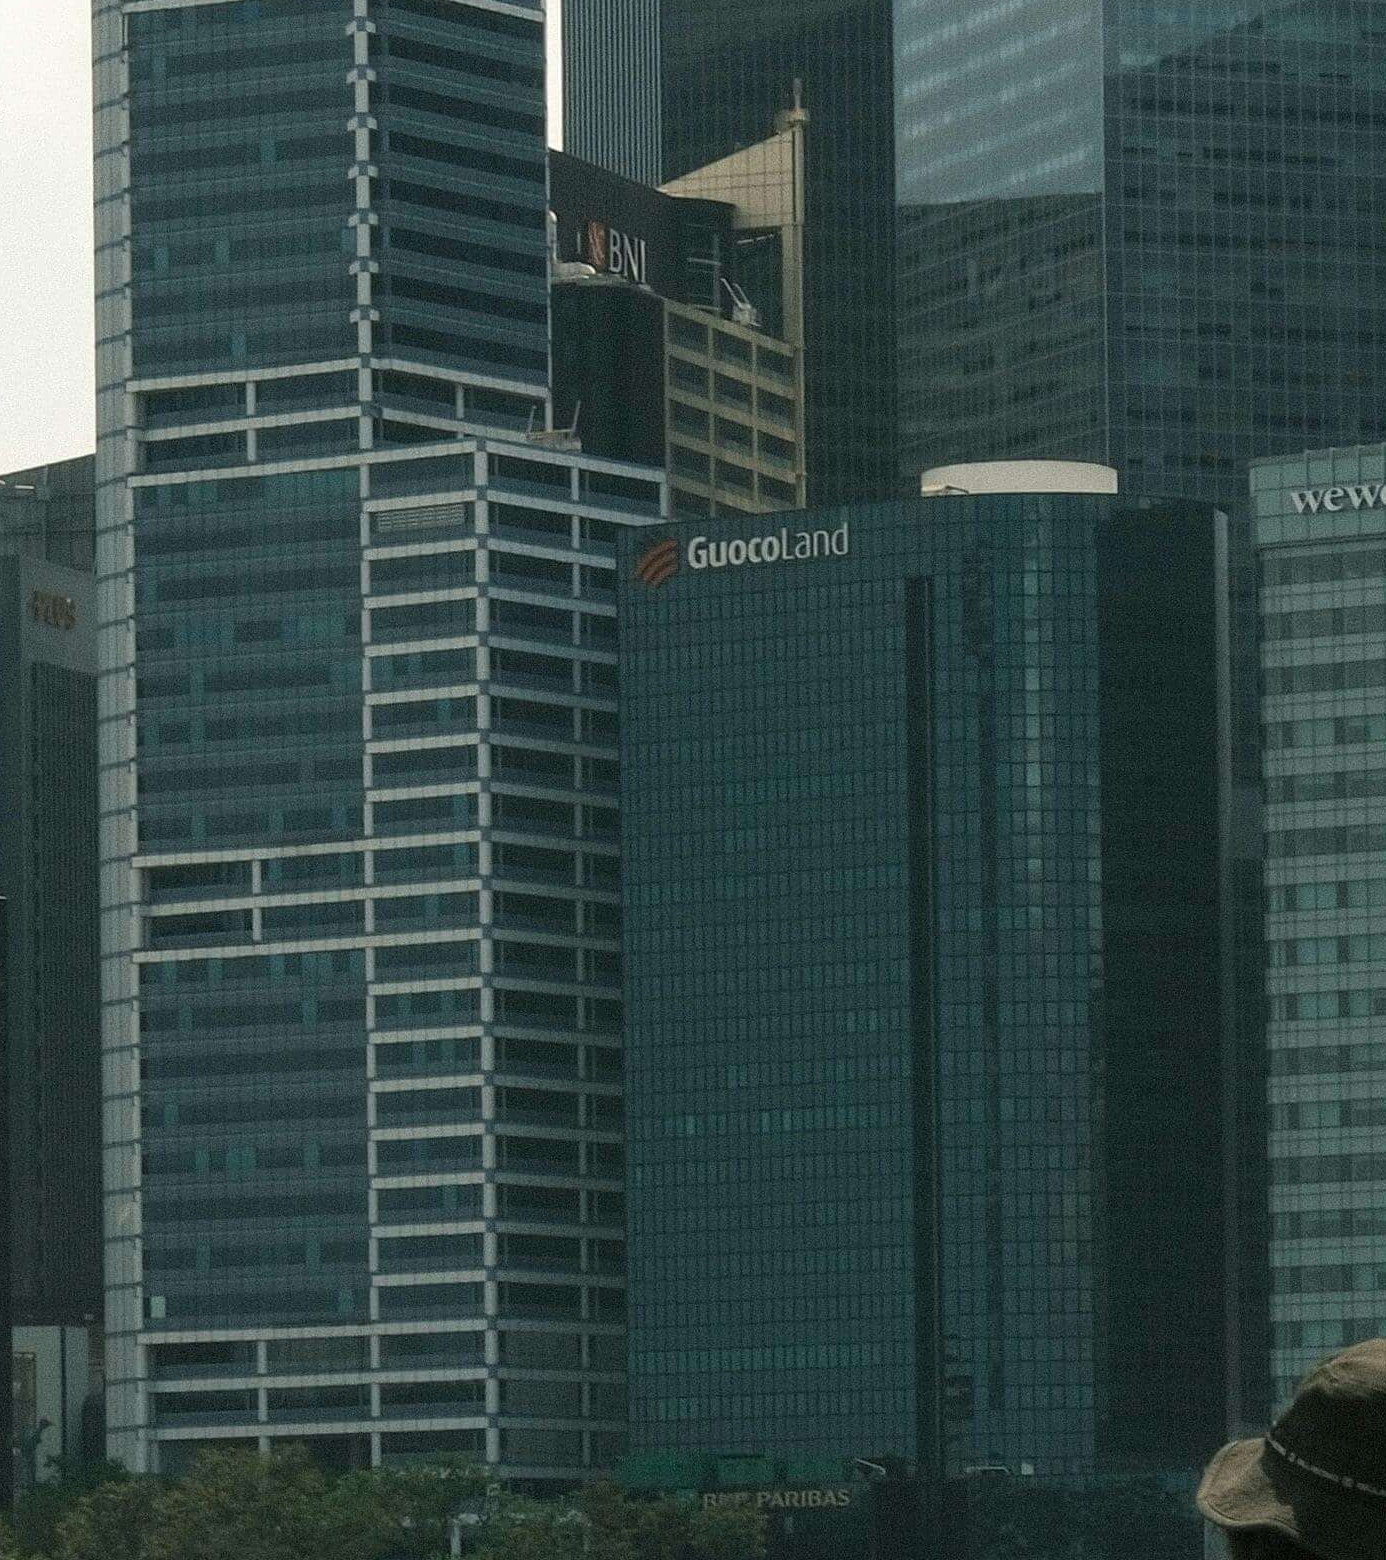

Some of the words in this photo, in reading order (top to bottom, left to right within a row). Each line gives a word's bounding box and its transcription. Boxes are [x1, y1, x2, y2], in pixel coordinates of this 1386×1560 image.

[609, 228, 646, 283] BNI
[688, 522, 849, 569] GuocoLand
[756, 1489, 851, 1508] PARIBAS
